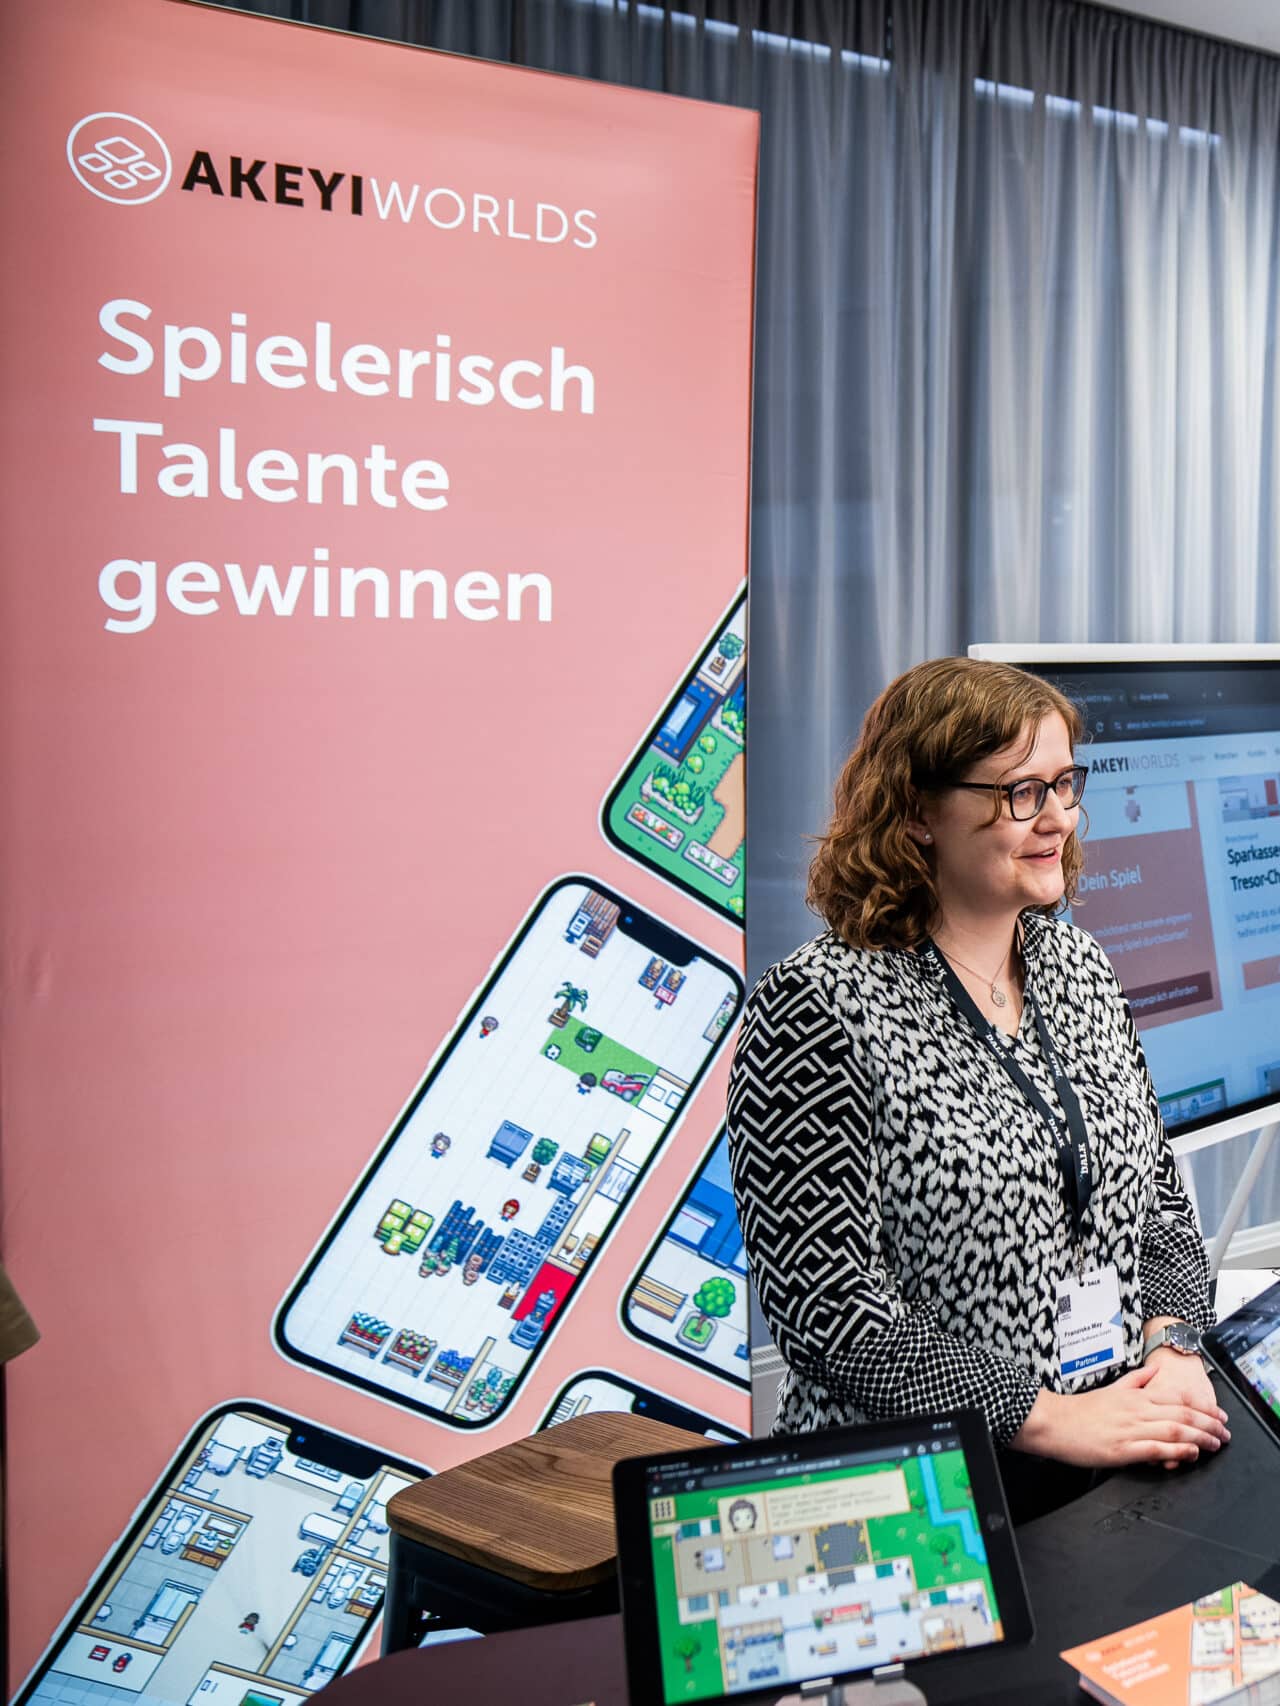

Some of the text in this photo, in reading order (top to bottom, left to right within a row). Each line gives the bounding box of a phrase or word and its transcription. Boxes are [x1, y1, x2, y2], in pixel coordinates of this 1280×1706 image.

[97, 298, 596, 415] Spielerisch
[92, 417, 451, 512] Talente
[97, 547, 554, 635] gewinnen
[1079, 864, 1143, 892] Dein Spiel
[985, 1033, 1007, 1059] DALK
[1048, 1118, 1066, 1149] DALK
[1078, 1142, 1089, 1174] DALK
[1075, 1355, 1099, 1369] Partner
